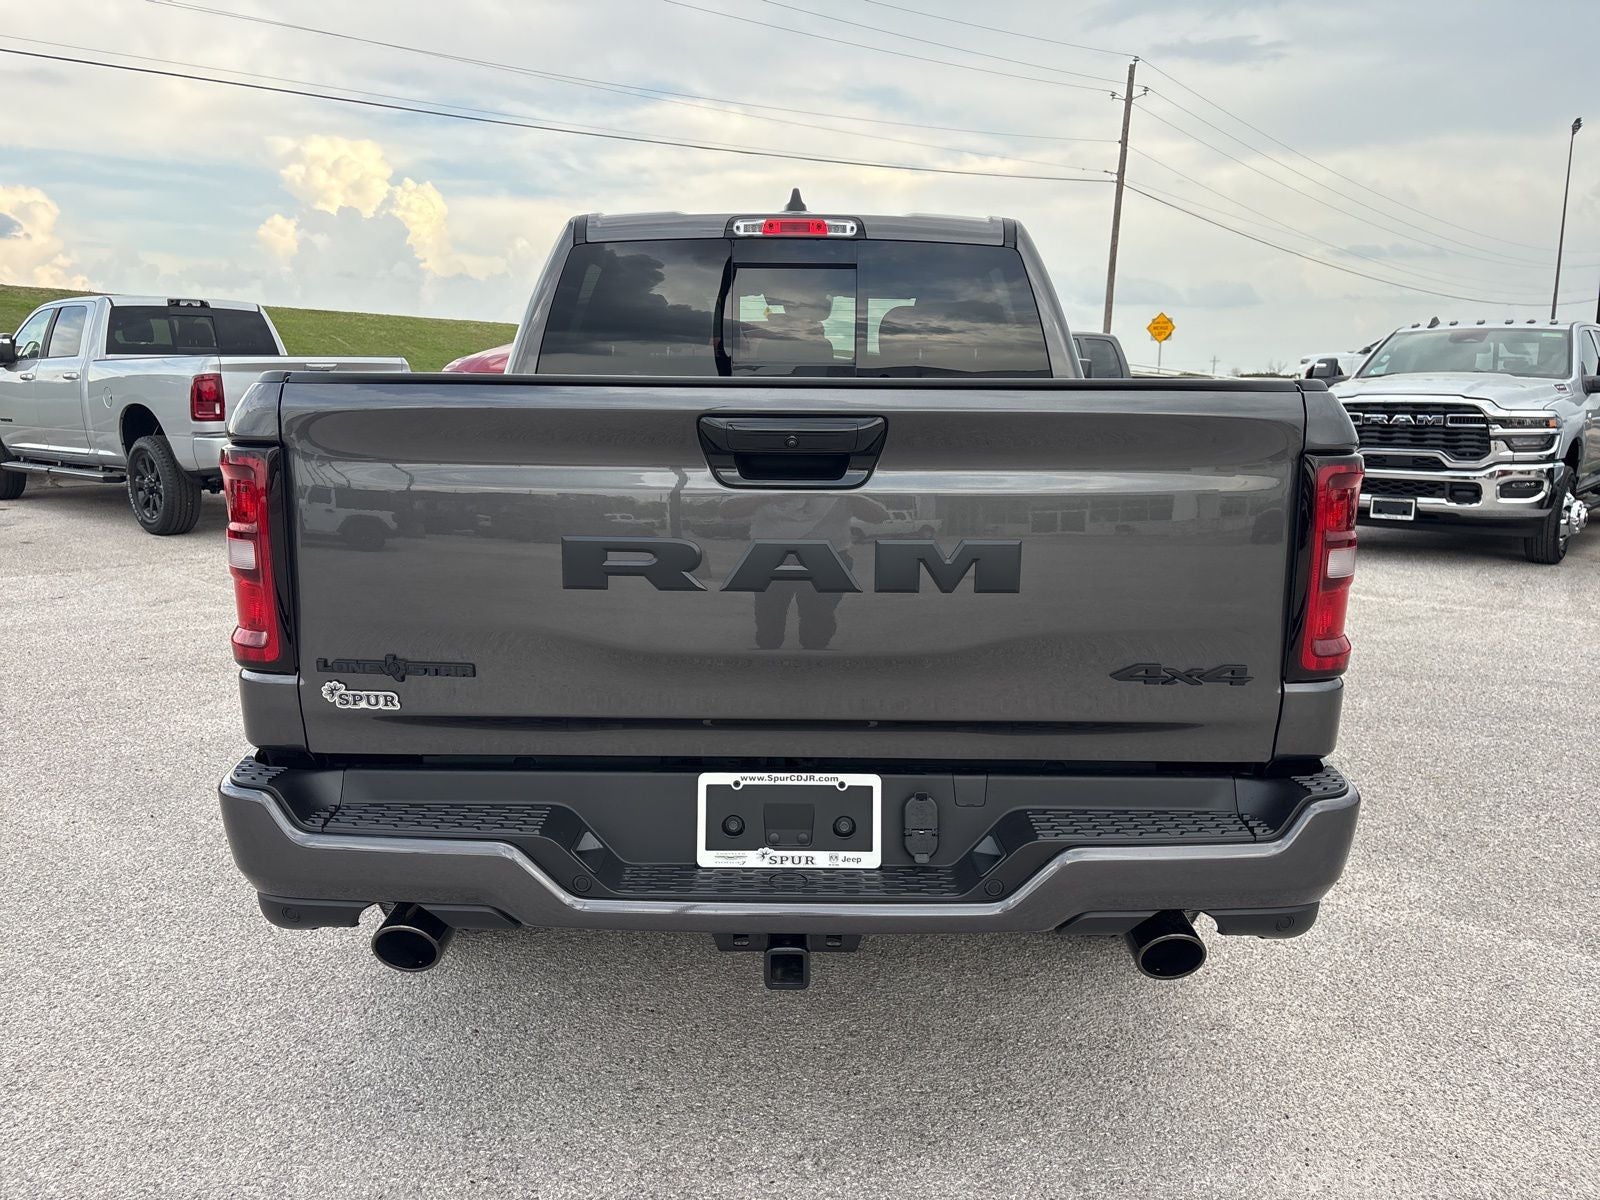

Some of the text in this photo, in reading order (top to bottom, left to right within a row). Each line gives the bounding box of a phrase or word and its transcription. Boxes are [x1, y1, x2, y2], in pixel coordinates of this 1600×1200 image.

[1363, 414, 1444, 425] RAM
[561, 536, 1022, 593] RAM
[338, 693, 397, 707] SPUR
[740, 774, 839, 783] www.SpurCDJR.com
[768, 855, 862, 866] SPUR Jeep
